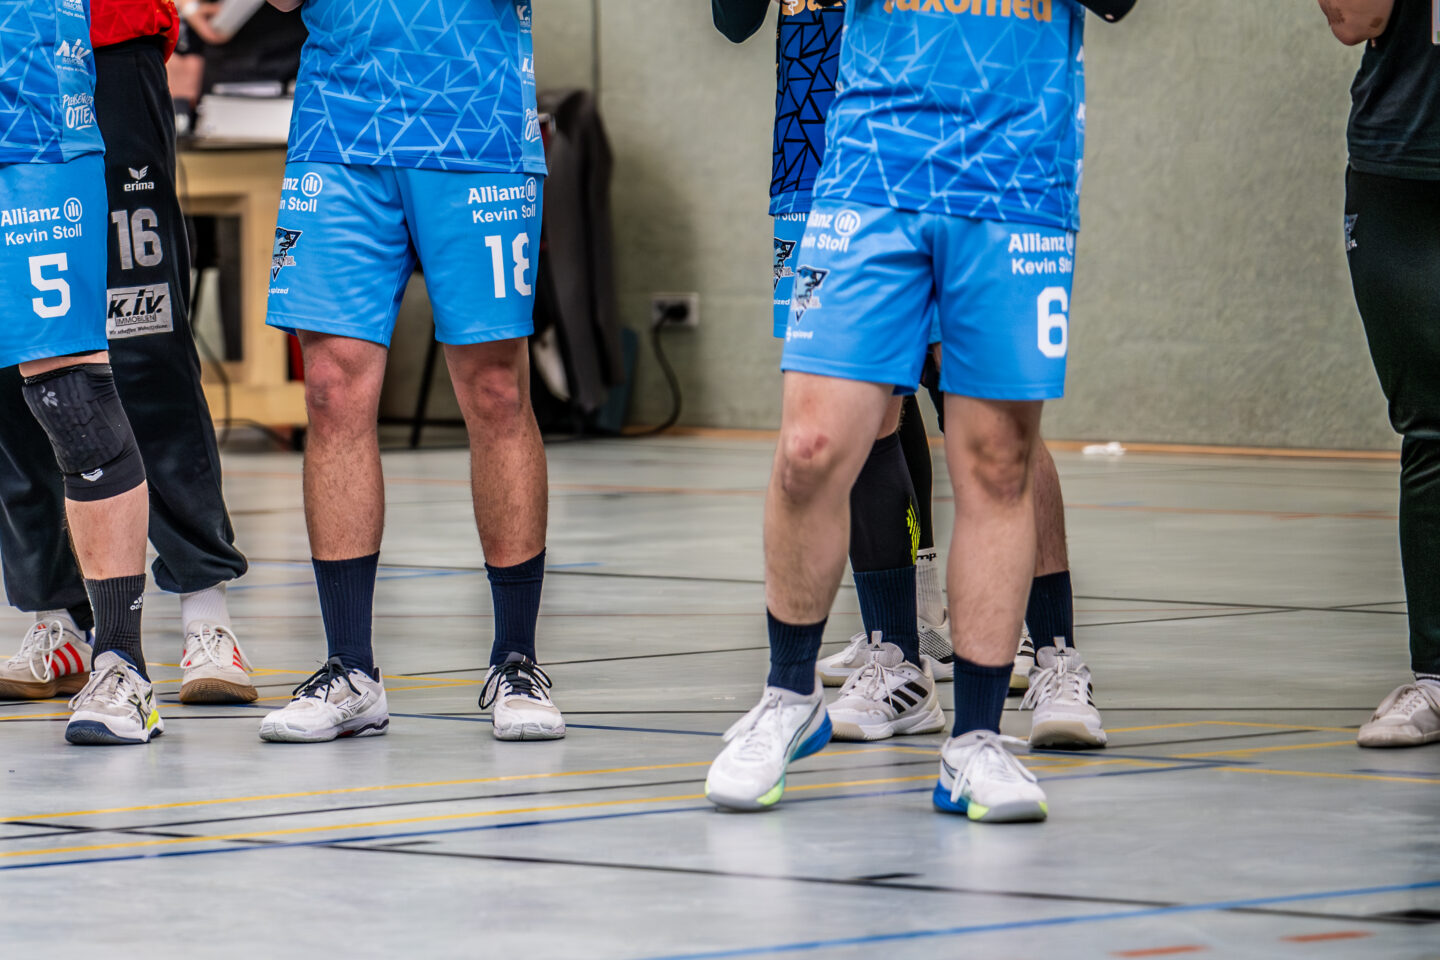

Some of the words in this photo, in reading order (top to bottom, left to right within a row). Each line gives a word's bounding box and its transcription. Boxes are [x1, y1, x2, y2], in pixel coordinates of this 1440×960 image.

[123, 181, 155, 192] erima
[467, 185, 525, 204] Allianz
[288, 197, 317, 212] Stoll
[0, 207, 60, 227] Allianz
[472, 207, 517, 224] Kevin
[5, 228, 48, 246] Kevin
[53, 223, 82, 240] Stoll
[111, 208, 163, 271] 16
[817, 233, 850, 253] Stoll
[1008, 232, 1065, 253] Allianz
[484, 232, 532, 298] 18
[1012, 257, 1057, 275] Kevin
[29, 252, 71, 318] 5
[1037, 286, 1068, 358] 6
